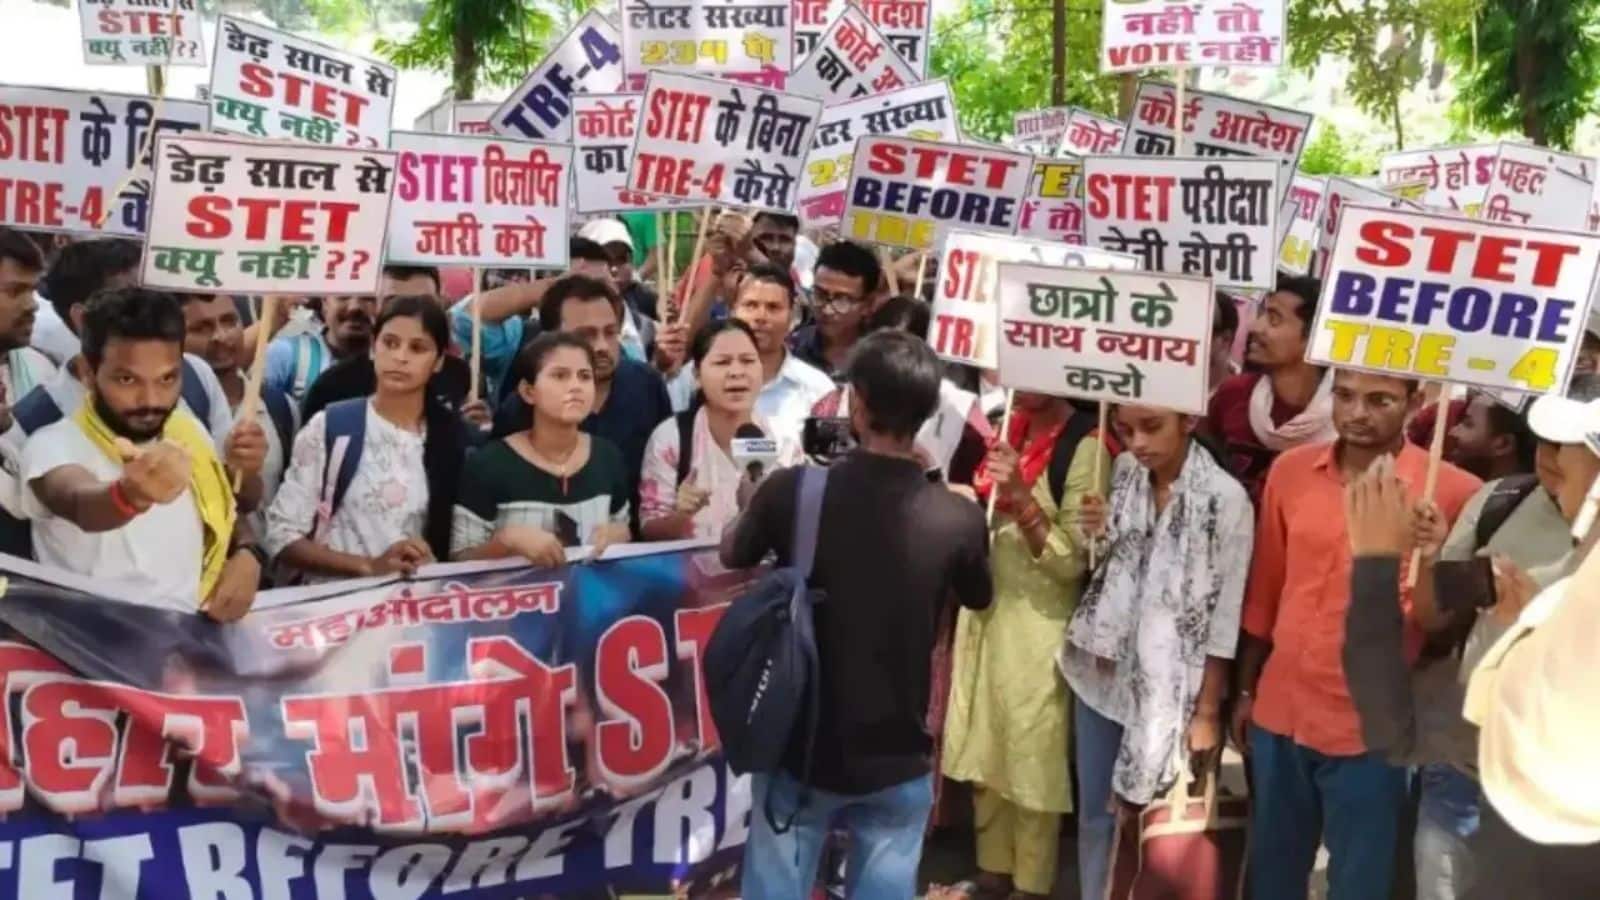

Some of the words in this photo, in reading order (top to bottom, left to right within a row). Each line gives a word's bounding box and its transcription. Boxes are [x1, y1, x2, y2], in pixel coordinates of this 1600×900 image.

[97, 11, 184, 35] STET
[626, 0, 692, 29] लेटर
[1122, 5, 1203, 36] नहीं
[1213, 3, 1263, 32] तो
[85, 39, 126, 62] क्यू
[225, 20, 272, 62] डेढ़
[283, 44, 354, 84] साल
[365, 66, 393, 97] से
[835, 17, 884, 72] कोर्ट
[1108, 42, 1191, 67] VOTE
[1198, 36, 1280, 62] नहीं
[502, 26, 621, 138] TRE-4
[815, 46, 853, 93] का
[214, 95, 269, 137] क्यू
[278, 111, 341, 143] नहीं
[239, 63, 370, 127] STET
[575, 99, 635, 139] कोर्ट
[861, 95, 947, 136] संख्या
[80, 97, 116, 167] के
[647, 87, 712, 144] STET
[714, 88, 746, 147] के
[746, 94, 811, 157] बिना
[1069, 120, 1124, 153] कोर्ट
[1210, 108, 1304, 154] आदेश
[167, 144, 231, 192] डेढ़
[245, 158, 341, 191] साल
[355, 157, 392, 194] से
[398, 152, 478, 201] STET
[581, 145, 627, 173] का
[637, 152, 724, 200] TRE-4
[732, 158, 795, 208] कैसे
[868, 141, 1018, 190] STET
[186, 195, 360, 243] STET
[852, 177, 1016, 226] BEFORE
[1047, 202, 1082, 230] तो
[1087, 172, 1176, 223] STET
[1179, 164, 1273, 226] परीक्षा
[413, 212, 482, 257] जारी
[493, 215, 547, 258] करो
[1178, 231, 1258, 281] होगी
[1356, 221, 1580, 287] STET
[151, 246, 224, 287] क्यू
[238, 244, 320, 279] नहीं
[1027, 277, 1119, 323] छात्रो
[1130, 281, 1178, 328] के
[1330, 271, 1575, 343] BEFORE
[1003, 319, 1085, 353] साथ
[1096, 329, 1200, 367] न्याय
[1064, 364, 1146, 398] करो
